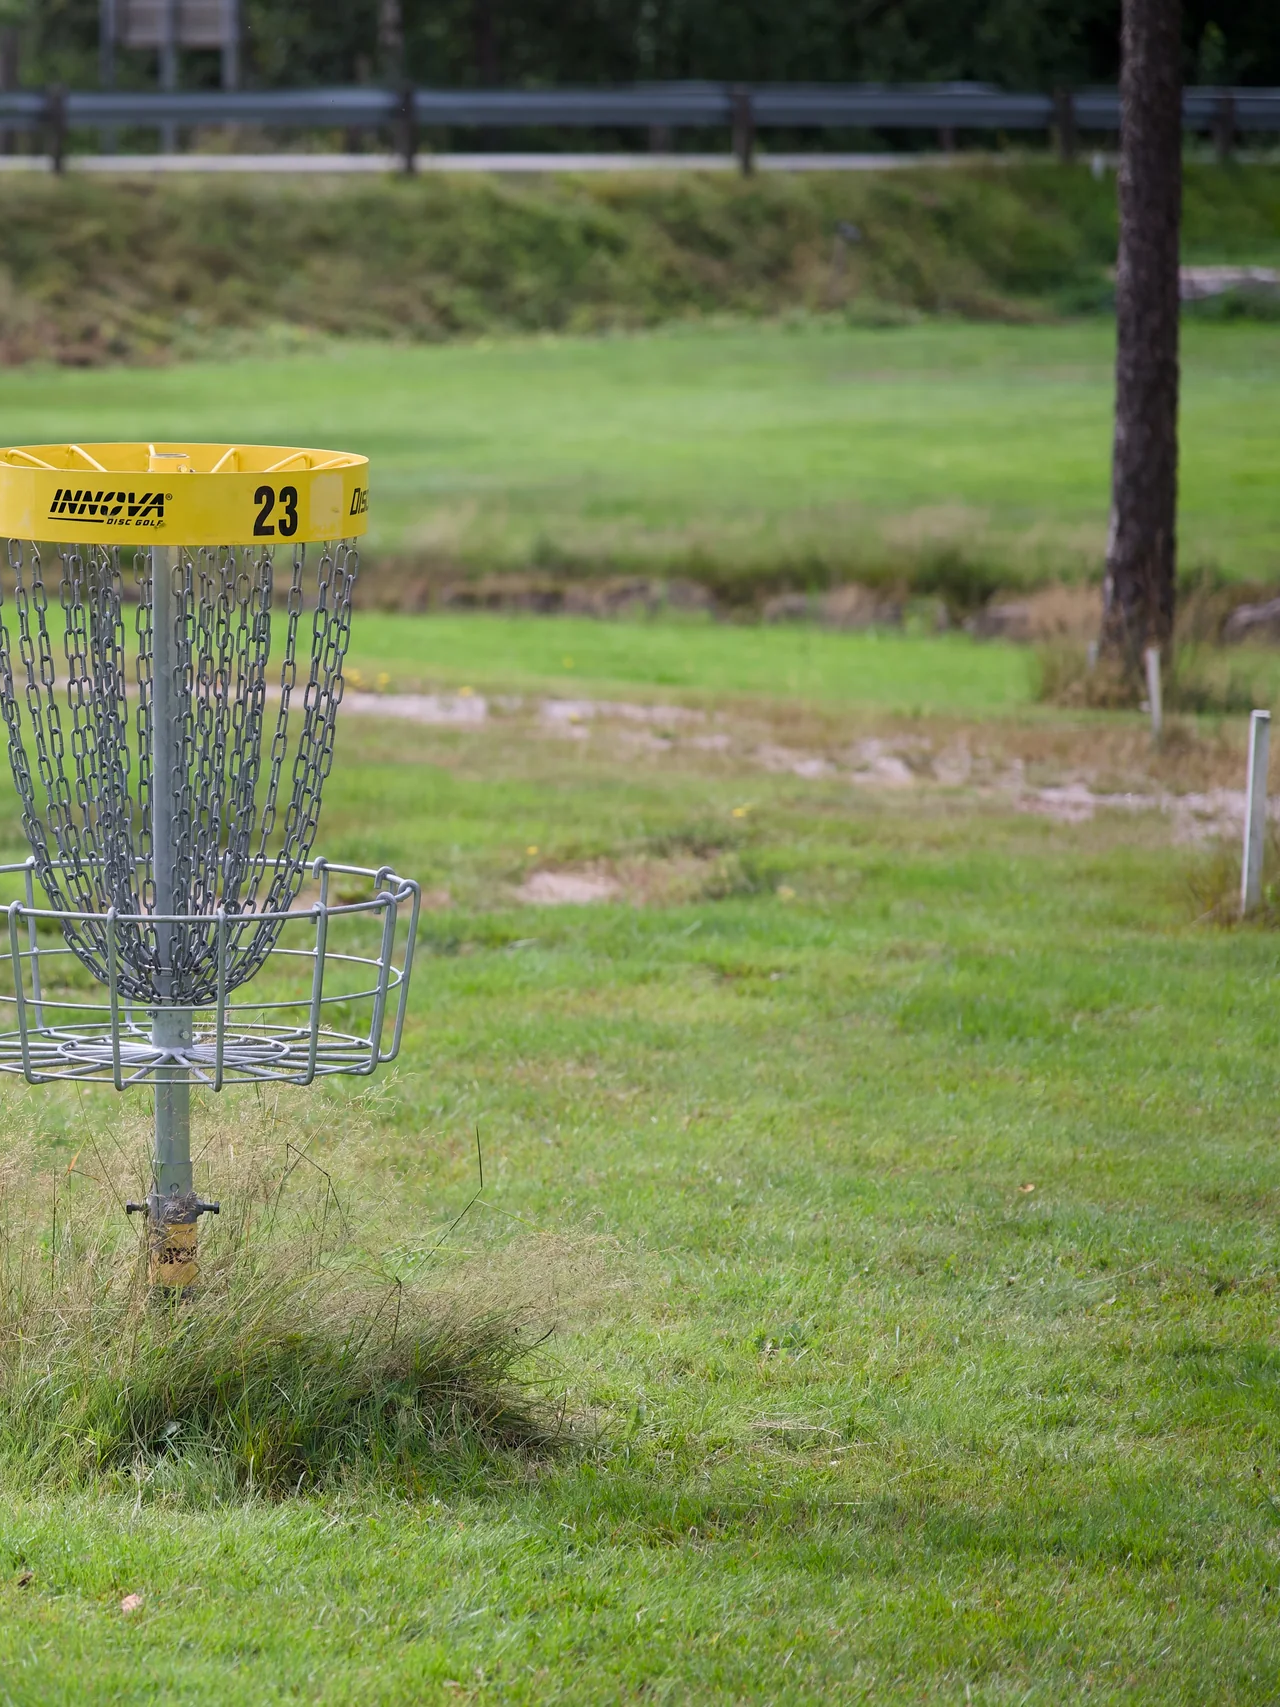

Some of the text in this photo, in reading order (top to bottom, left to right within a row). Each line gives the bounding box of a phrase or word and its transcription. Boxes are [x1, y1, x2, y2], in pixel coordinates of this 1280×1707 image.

[106, 518, 164, 527] DISC GOLF
[253, 485, 298, 537] 23
